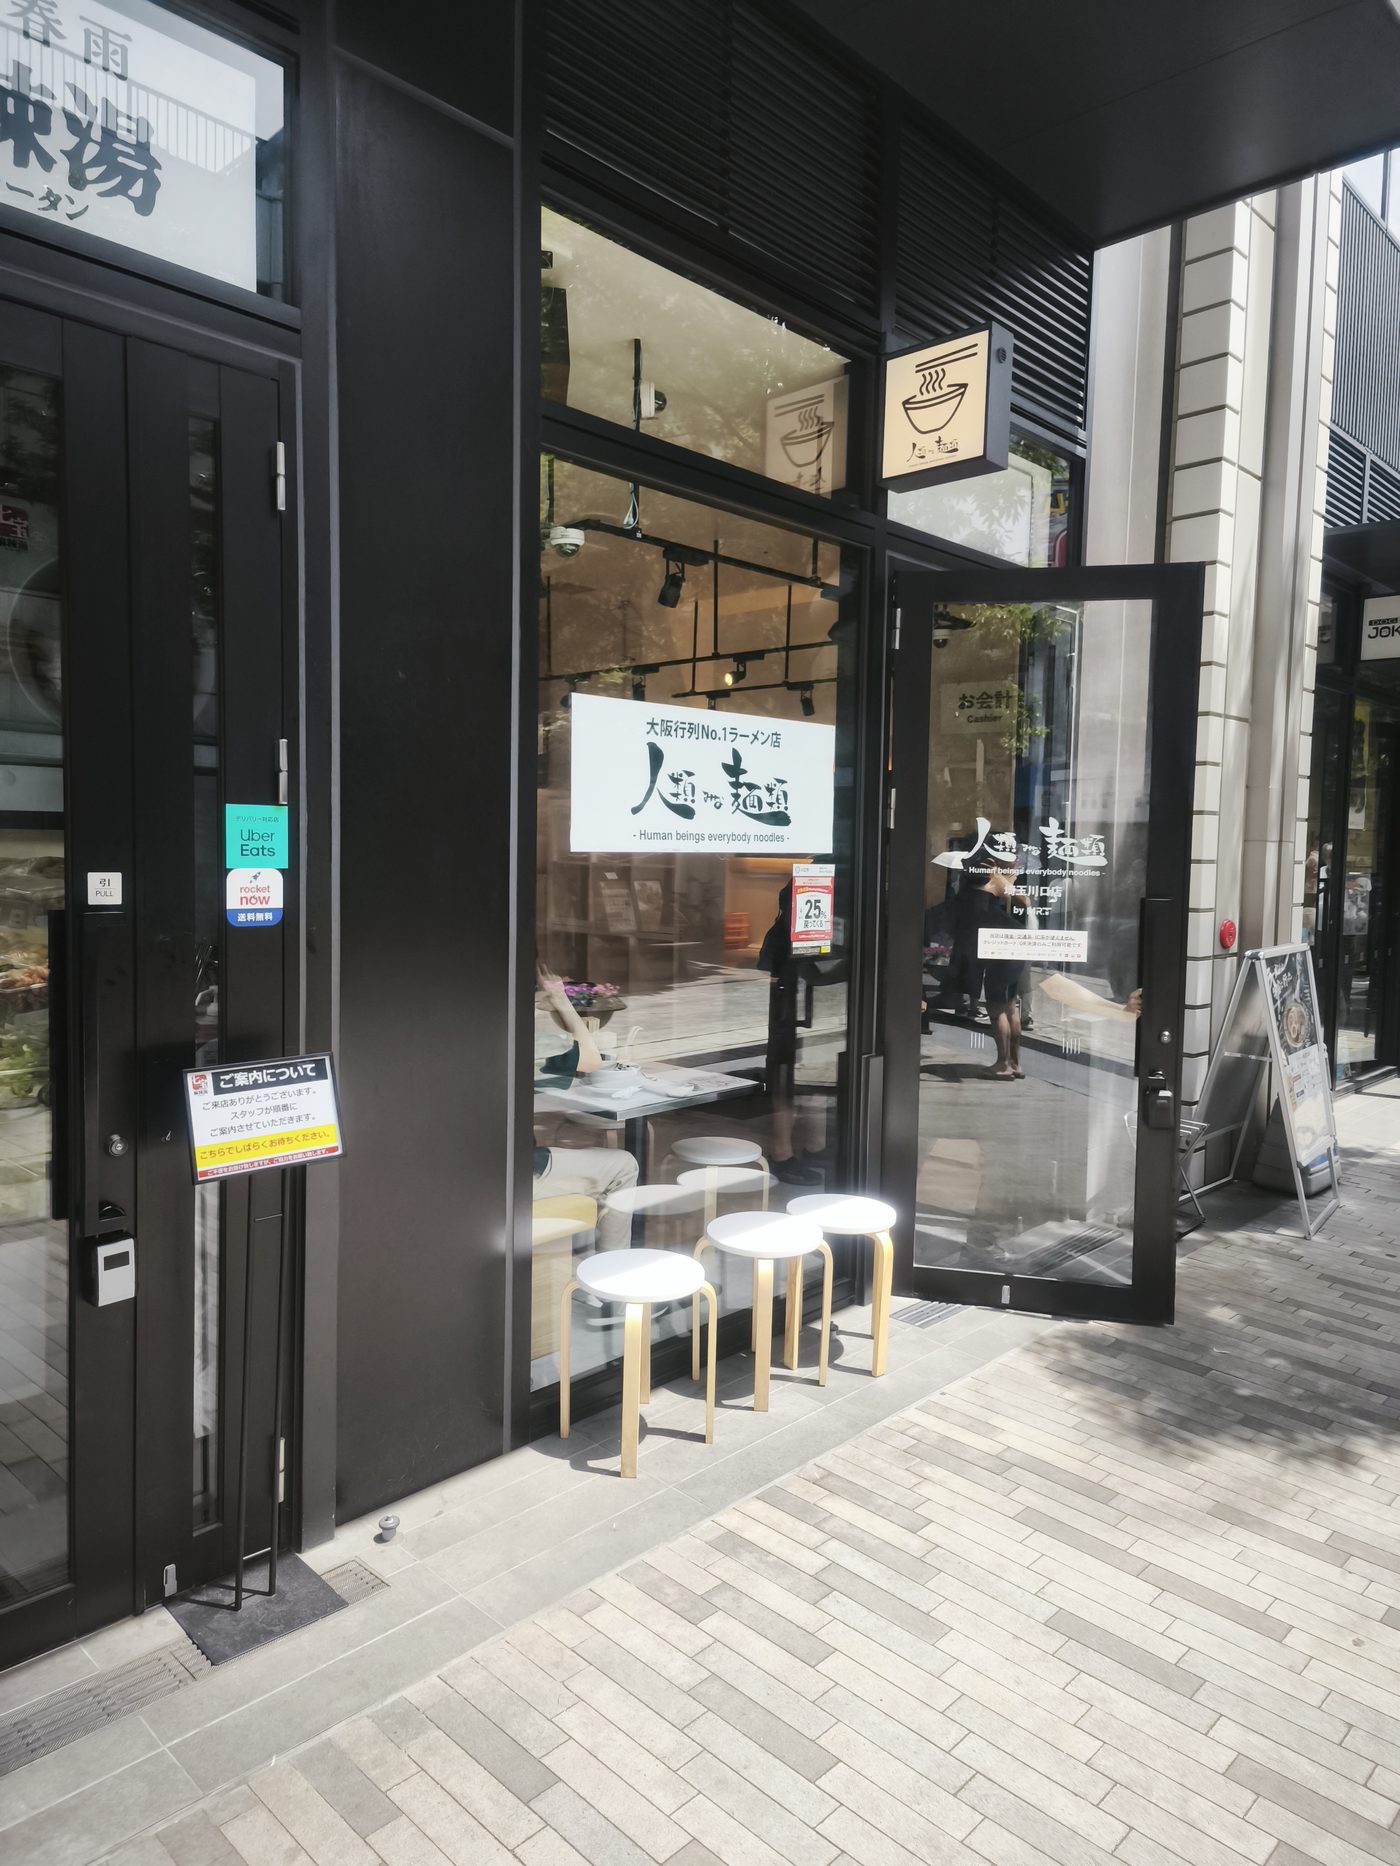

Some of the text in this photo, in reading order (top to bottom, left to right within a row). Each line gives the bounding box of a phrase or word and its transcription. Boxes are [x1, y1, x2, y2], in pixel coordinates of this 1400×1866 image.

[967, 713, 1002, 723] Cashier
[646, 717, 782, 748] 大阪行列No.1ラーメン店
[240, 829, 275, 842] Uber
[639, 829, 785, 844] Human beings everybody noodles
[240, 844, 276, 857] Eats
[968, 866, 1101, 877] Human beings everybody noodles
[95, 890, 114, 898] PULL
[240, 885, 271, 895] rocket
[240, 895, 271, 906] now
[237, 912, 274, 923] 送料無料
[1013, 906, 1025, 916] by
[219, 1064, 316, 1088] ご案内について
[202, 1087, 317, 1111] ご来店ありがとうございます。
[230, 1102, 298, 1120] スタッフが順番に
[210, 1112, 316, 1137] ご案内させていただきます。
[200, 1131, 330, 1161] こちらでしばらくお待ちください。
